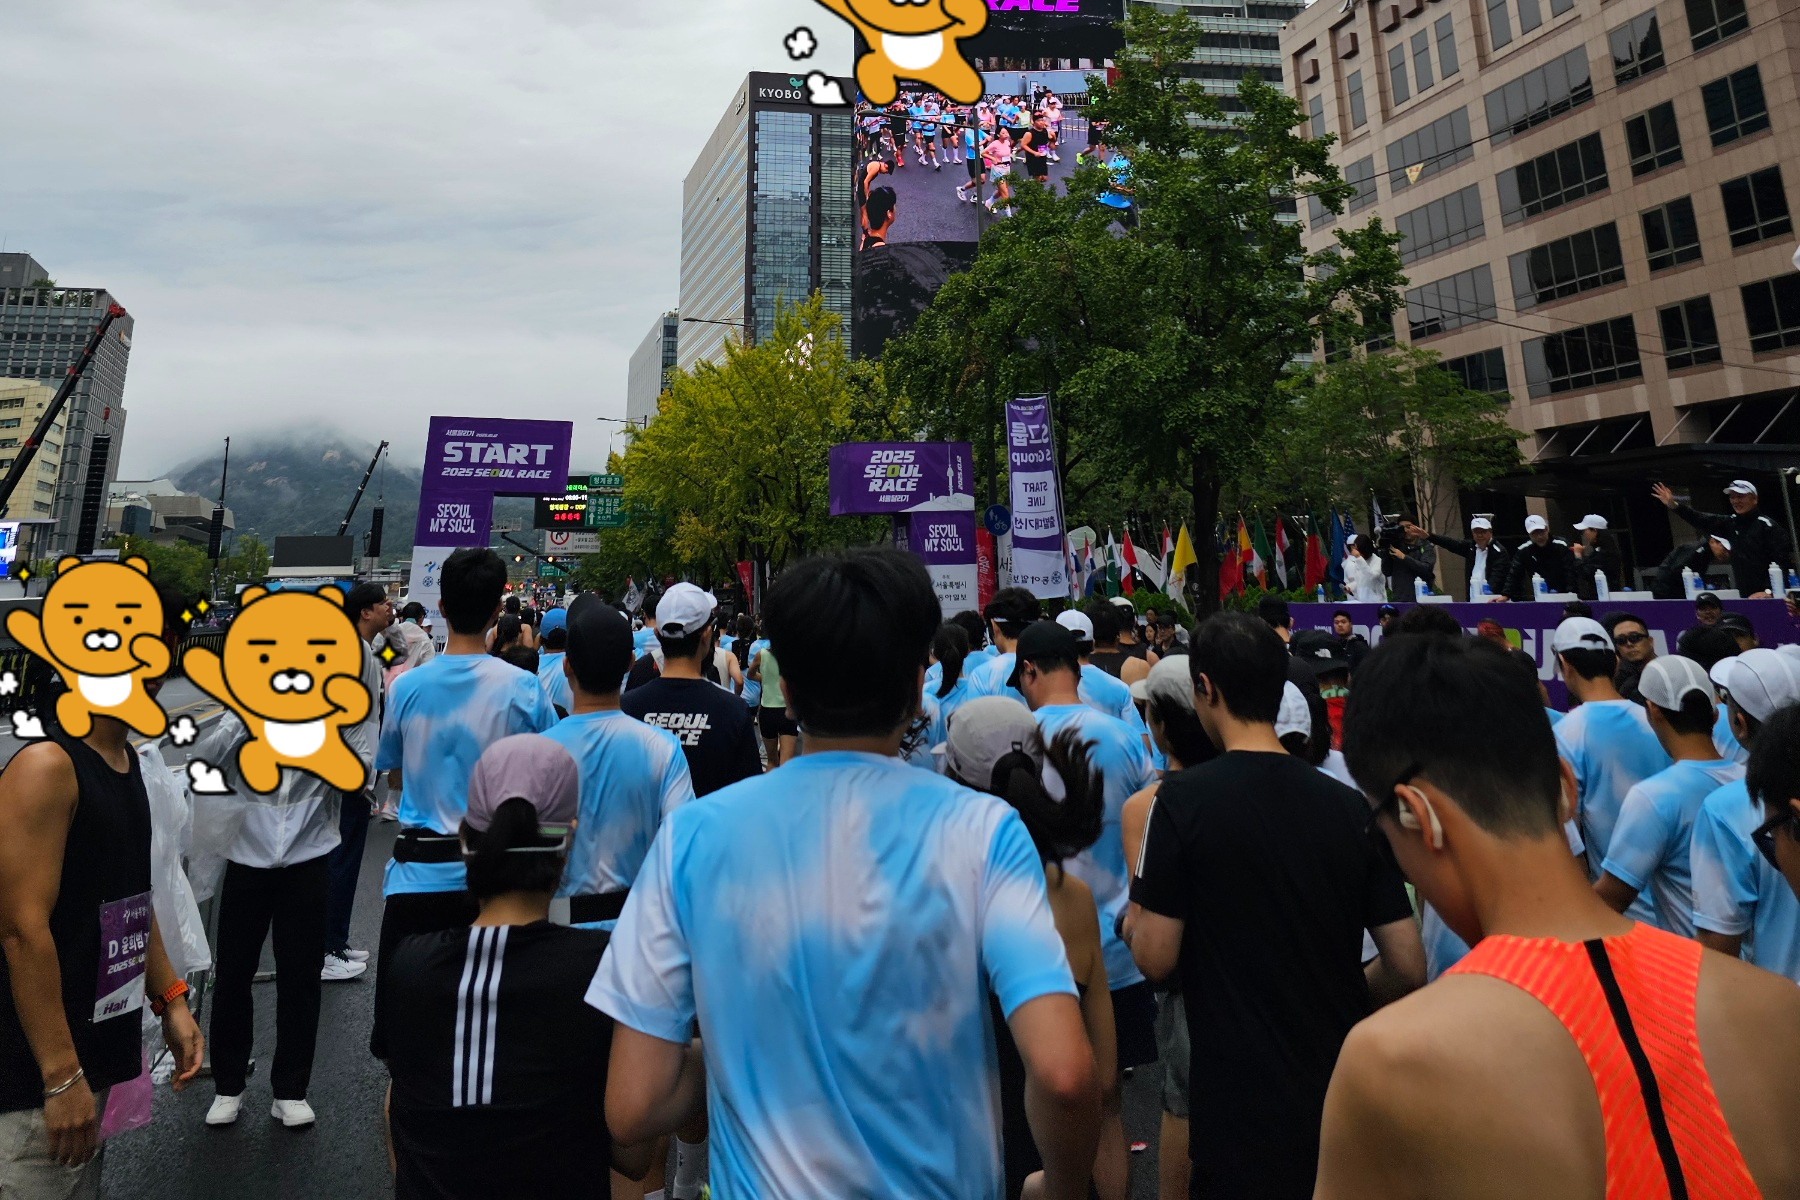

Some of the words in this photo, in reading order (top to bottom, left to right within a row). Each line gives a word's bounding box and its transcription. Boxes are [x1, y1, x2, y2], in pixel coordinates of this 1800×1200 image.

[759, 87, 802, 100] KYOBO
[442, 441, 554, 465] START
[870, 450, 916, 464] 2025
[441, 467, 475, 477] 2025
[473, 468, 515, 479] SEOUL
[516, 469, 552, 479] RACE
[863, 464, 923, 478] SEOUL
[868, 478, 919, 492] RACE
[448, 518, 476, 534] SOUL
[940, 537, 965, 552] SOUL
[935, 581, 967, 590] 서울특별시
[643, 712, 712, 730] SEOUL
[666, 729, 703, 746] CE
[108, 939, 119, 959] D
[102, 996, 129, 1016] Half
